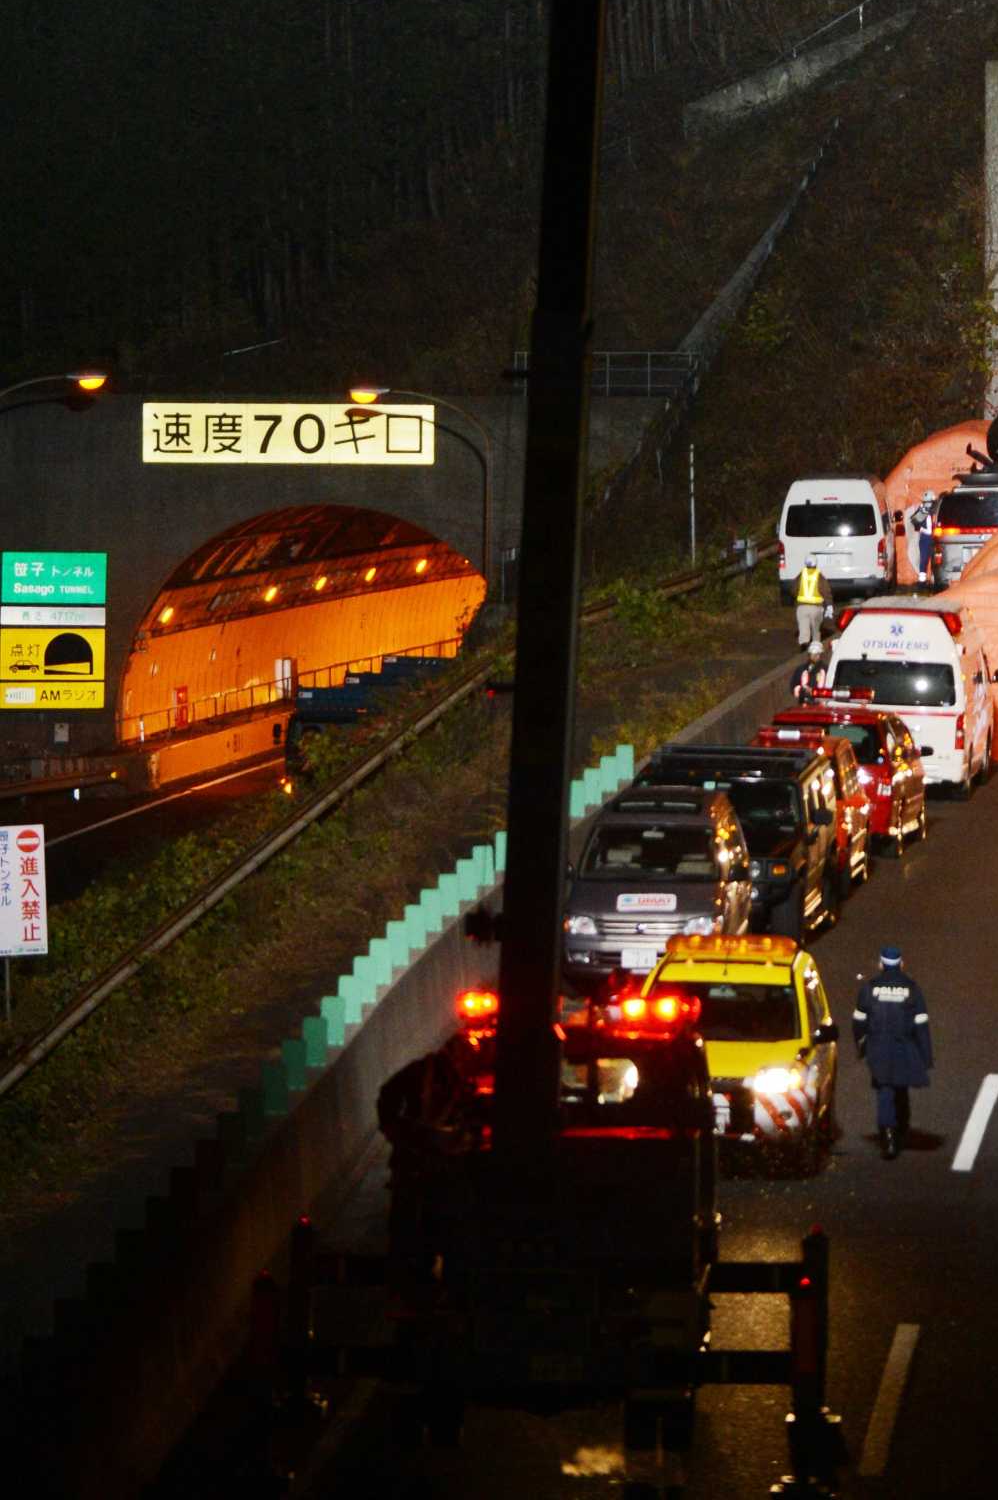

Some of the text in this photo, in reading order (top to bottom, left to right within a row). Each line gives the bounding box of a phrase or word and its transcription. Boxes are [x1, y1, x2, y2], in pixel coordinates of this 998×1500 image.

[152, 412, 423, 454] 速度70キロ
[51, 564, 94, 578] トンネル
[13, 582, 94, 596] Sasago TUNNEL
[10, 644, 40, 658] 点灯
[863, 639, 930, 650] OTSUKI EMS
[40, 689, 96, 702] AMラジオ
[20, 855, 41, 943] 進入禁止
[872, 986, 910, 998] POLICE
